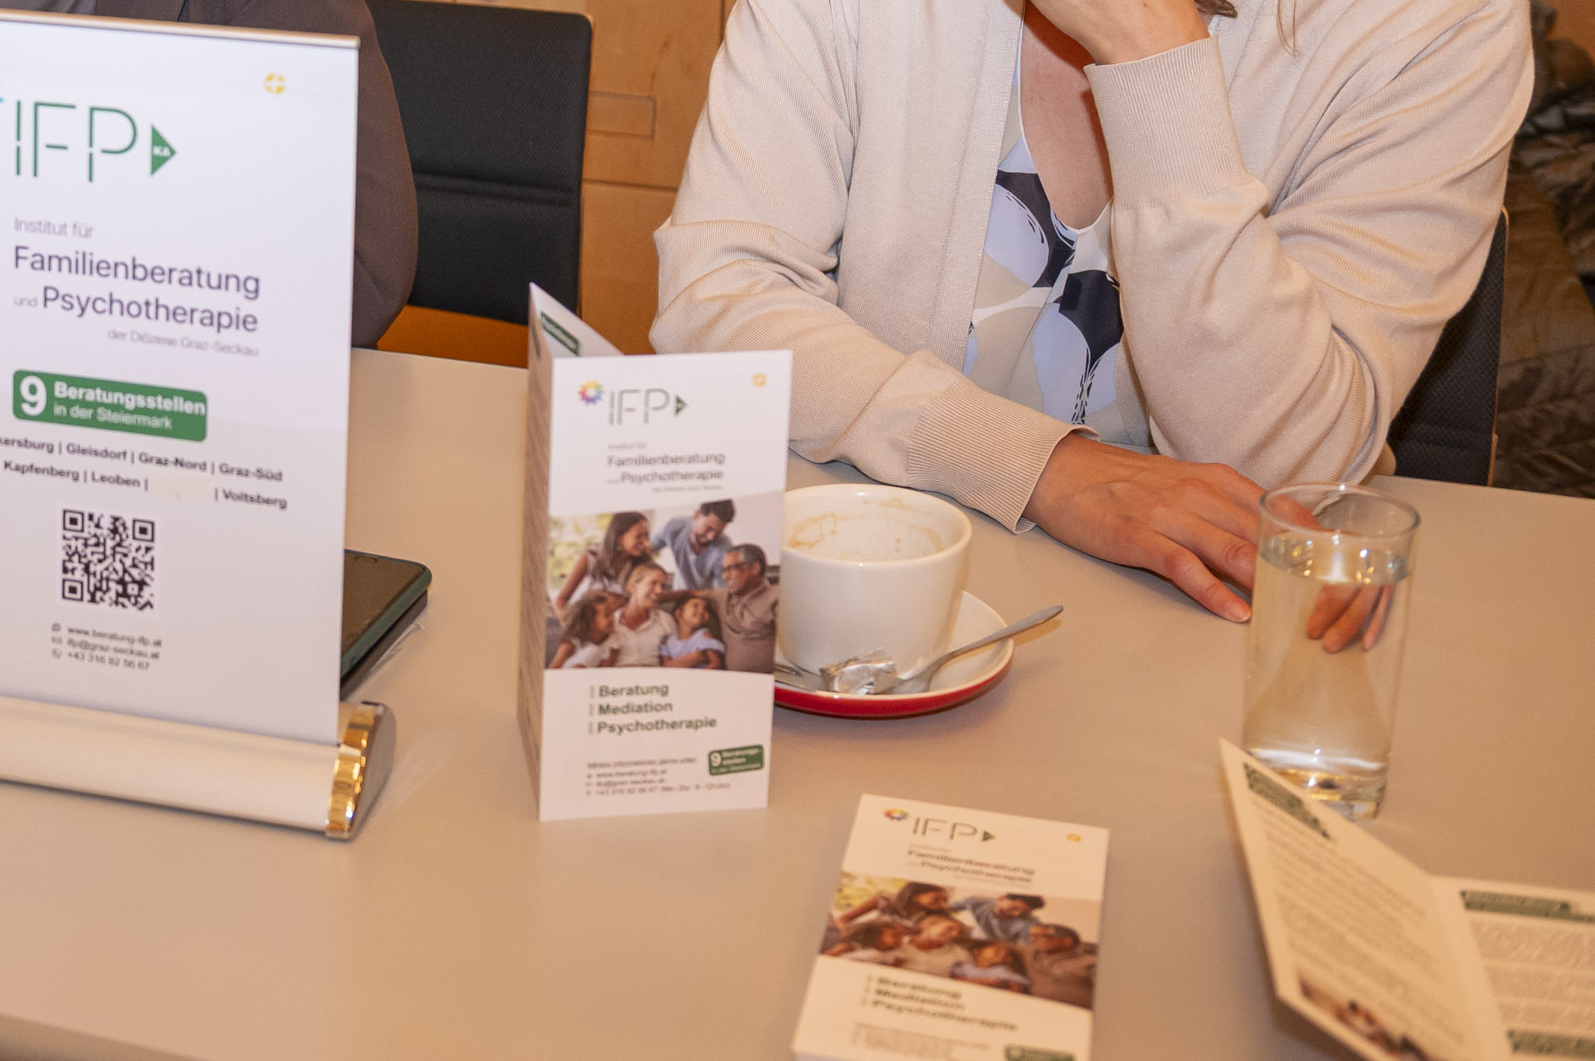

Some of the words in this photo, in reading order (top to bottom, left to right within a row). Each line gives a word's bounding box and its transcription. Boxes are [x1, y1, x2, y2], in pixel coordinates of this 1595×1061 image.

[15, 99, 138, 183] IFP
[13, 216, 68, 237] Institut
[72, 222, 94, 240] für
[14, 245, 261, 300] Familienberatung
[13, 295, 38, 308] und
[43, 286, 259, 333] Psychotherapie
[108, 328, 127, 340] der
[19, 375, 47, 416] 9
[54, 381, 205, 416] Beratungsstellen
[608, 388, 669, 426] IFP
[54, 402, 67, 417] in
[70, 404, 93, 420] der
[96, 407, 173, 429] Steiermark
[66, 442, 127, 460] Gleisdorf
[139, 451, 207, 471] Graz-Nord
[219, 462, 283, 482] Graz-Süd
[607, 453, 725, 467] Familienberatung
[4, 460, 79, 482] Kapfenberg
[91, 471, 141, 488] Leoben
[222, 489, 288, 511] Voitsberg
[621, 470, 724, 484] Psychotherapie
[599, 684, 669, 697] Beratung
[598, 701, 673, 715] Mediation
[597, 717, 717, 736] Psychotherapie
[710, 752, 722, 767] 9
[912, 817, 978, 841] IFP
